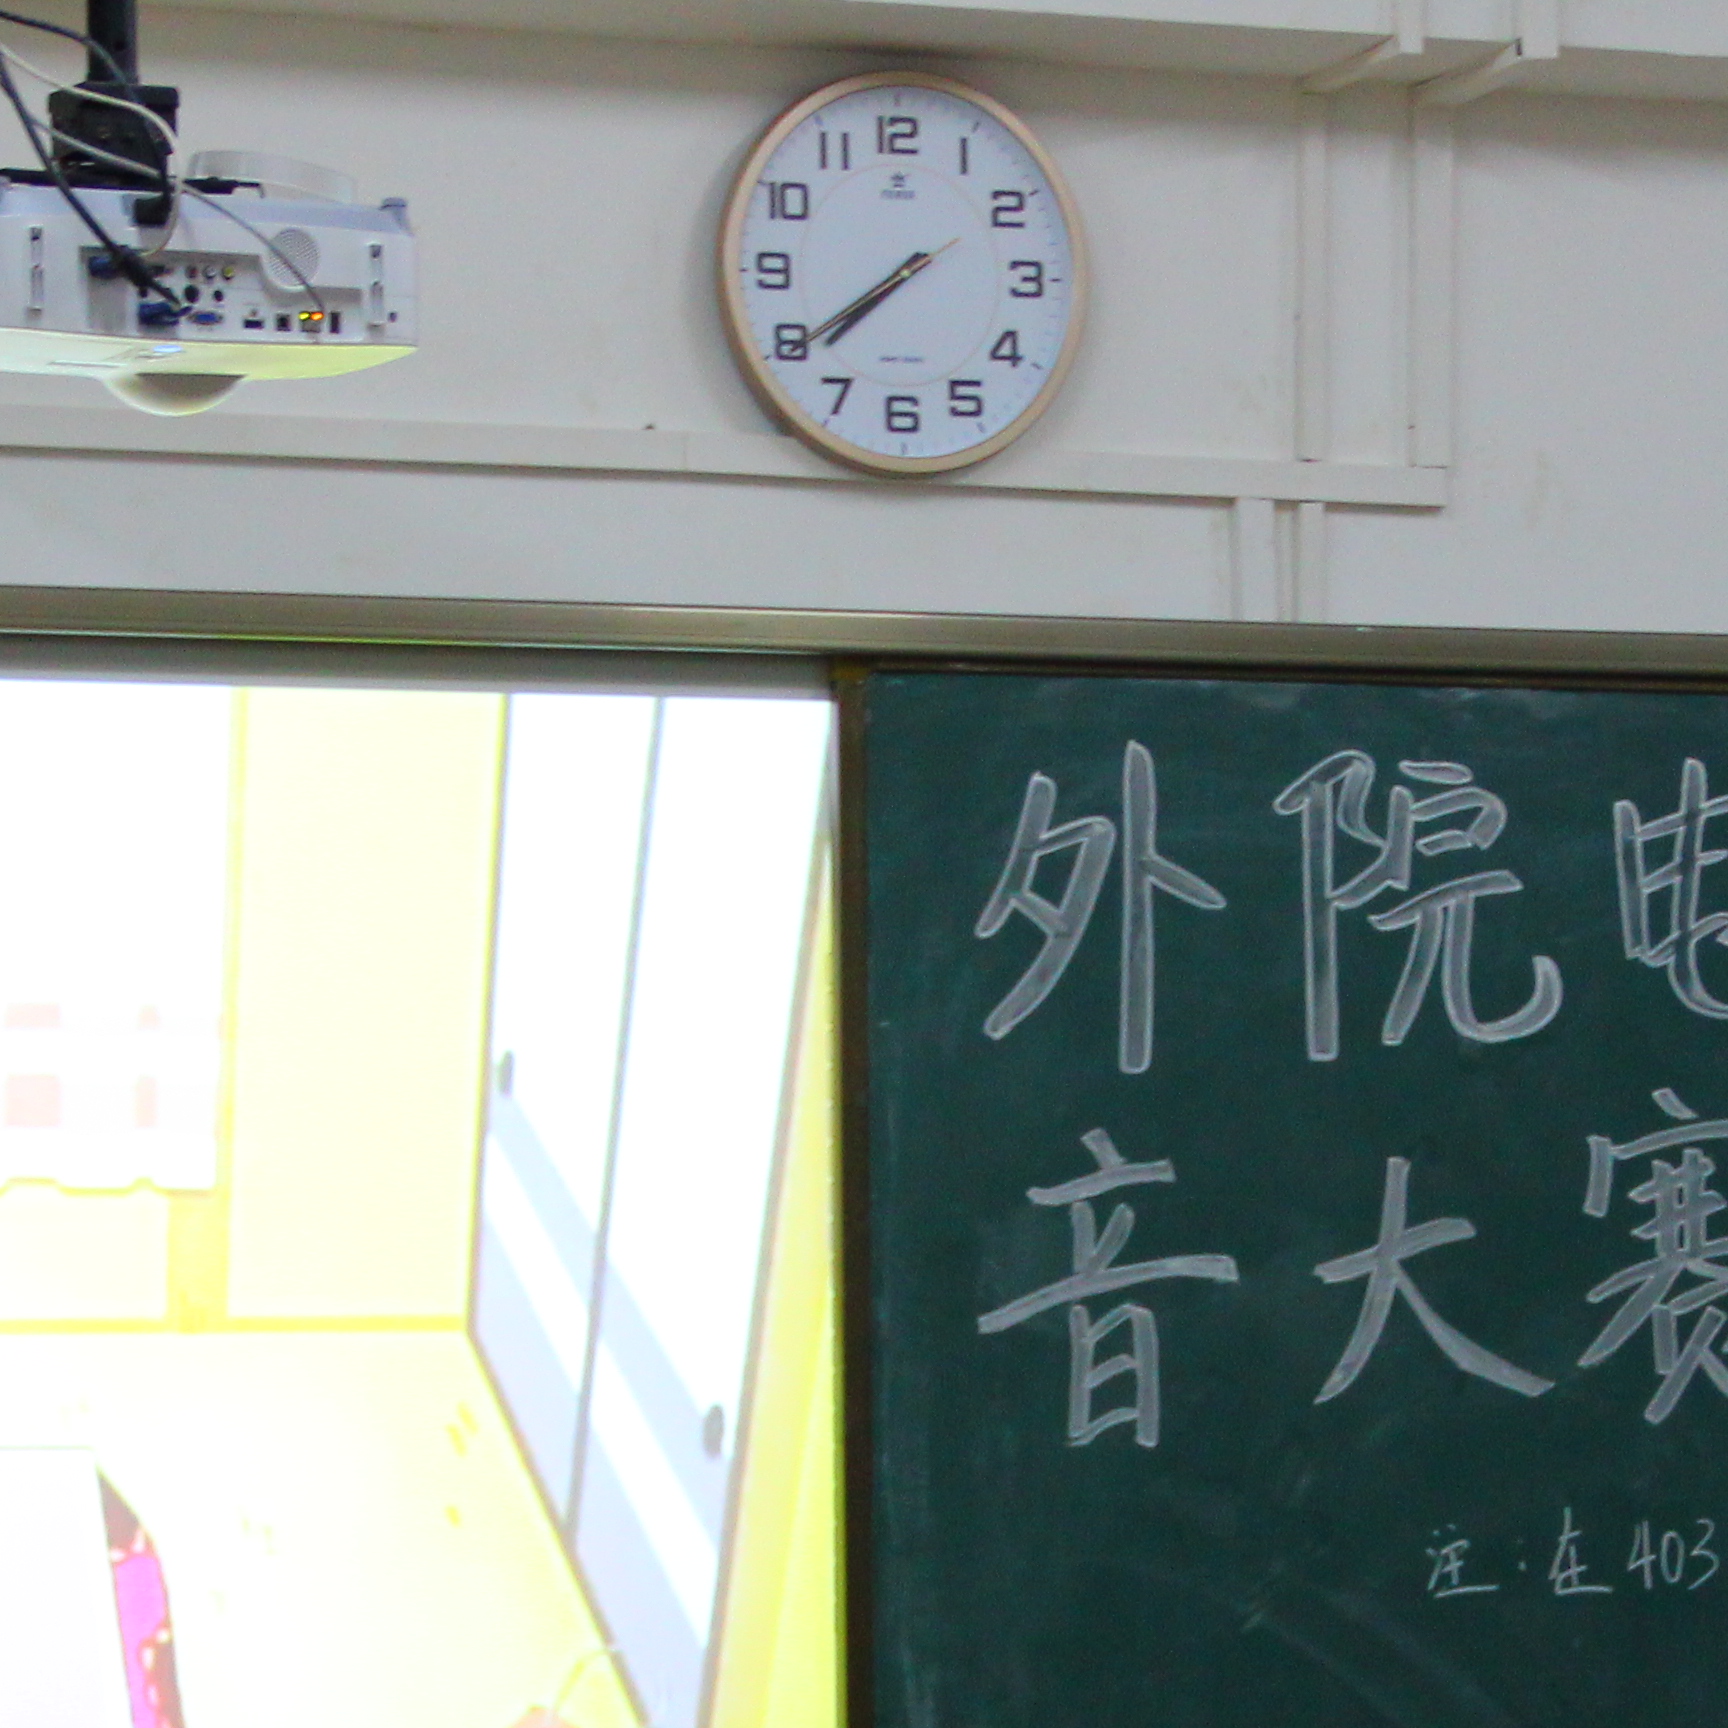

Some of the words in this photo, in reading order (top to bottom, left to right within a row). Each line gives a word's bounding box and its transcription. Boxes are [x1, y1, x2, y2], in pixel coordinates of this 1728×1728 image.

[820, 132, 849, 170] 11
[877, 115, 919, 154] 12
[959, 136, 969, 174] 1
[769, 181, 809, 220] 10
[991, 190, 1026, 228] 2
[756, 252, 791, 290] 9
[1009, 260, 1044, 298] 3
[774, 323, 808, 361] 8
[989, 329, 1024, 368] 4
[821, 377, 853, 415] 7
[885, 395, 921, 433] 6
[948, 379, 983, 418] 5
